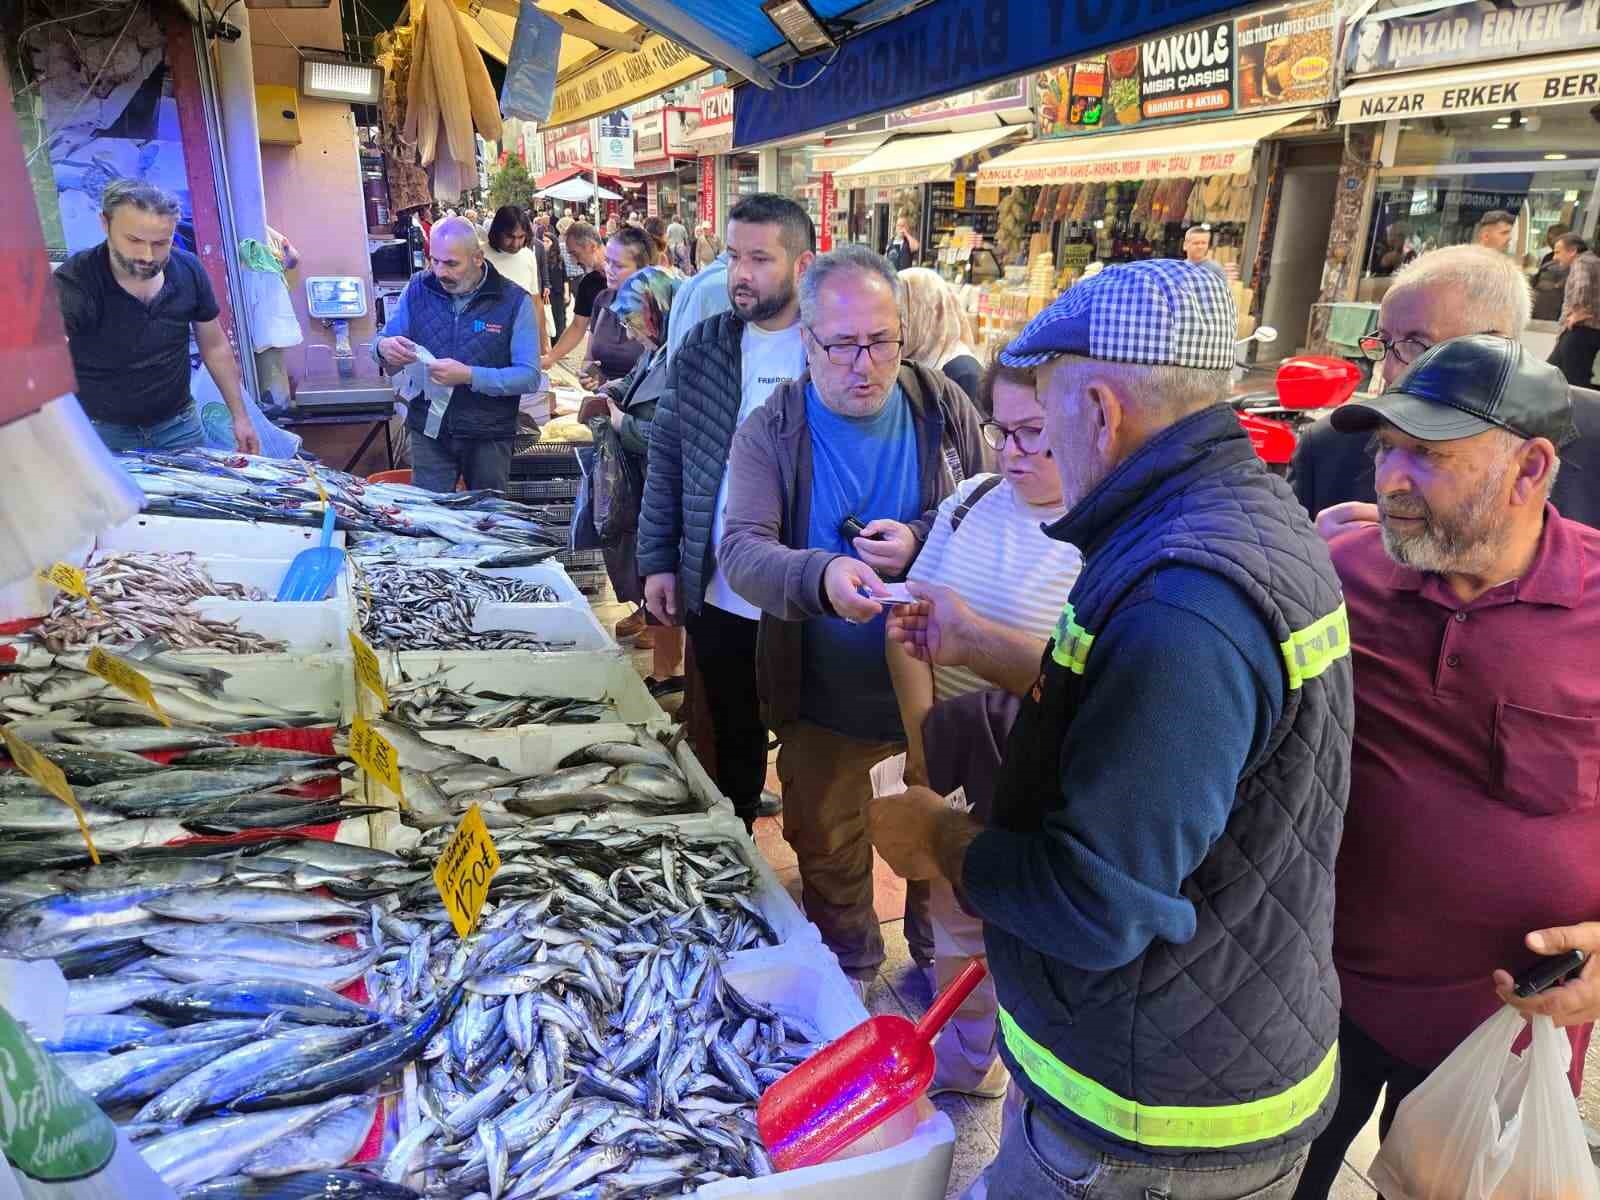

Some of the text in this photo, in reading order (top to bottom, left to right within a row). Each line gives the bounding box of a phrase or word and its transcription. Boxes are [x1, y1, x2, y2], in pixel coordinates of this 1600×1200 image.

[1142, 25, 1229, 77] KAKULE
[1390, 18, 1470, 60] NAZAR
[1480, 3, 1563, 49] ERKEK
[1143, 68, 1229, 95] MISIR ÇARŞISI
[1360, 72, 1600, 117] NAZAR ERKEK BER
